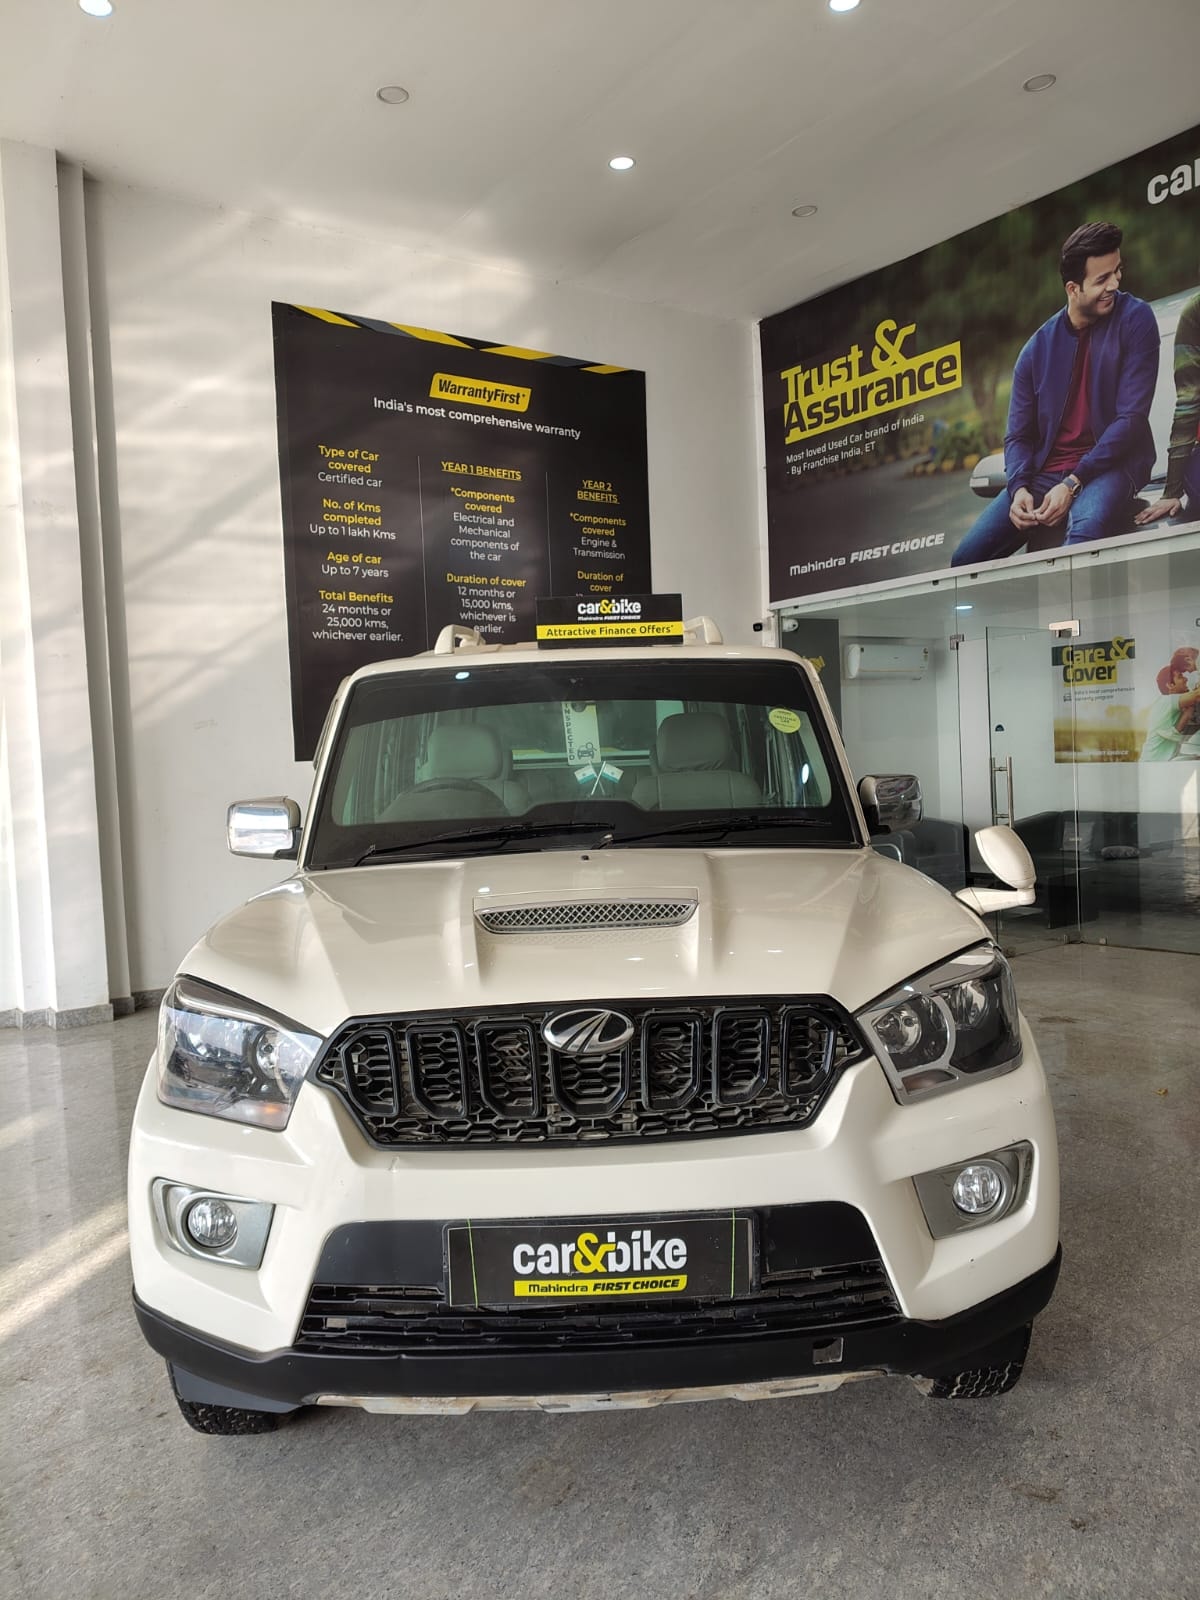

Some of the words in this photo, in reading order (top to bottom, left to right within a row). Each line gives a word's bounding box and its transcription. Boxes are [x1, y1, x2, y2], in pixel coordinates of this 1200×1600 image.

[780, 344, 864, 402] Trust
[871, 319, 917, 371] &
[785, 354, 958, 437] Assurance
[373, 397, 413, 413] India's
[415, 404, 446, 418] most
[448, 409, 533, 431] comprehensive
[534, 423, 581, 440] warranty
[786, 450, 805, 464] Most
[806, 442, 827, 458] loved
[828, 438, 848, 452] Used
[849, 433, 863, 444] Car
[864, 423, 889, 440] brand
[891, 419, 900, 431] of
[902, 413, 925, 427] India
[318, 444, 345, 458] Type
[347, 449, 359, 459] of
[361, 451, 380, 461] Car
[791, 464, 802, 475] By
[803, 452, 840, 471] Franchise
[840, 446, 864, 460] India,
[865, 441, 876, 453] ET
[328, 461, 372, 473] covered
[441, 461, 468, 474] YEAR
[469, 464, 474, 474] 1
[476, 465, 522, 481] BENEFITS
[317, 471, 364, 486] Certified
[366, 478, 383, 488] car
[582, 480, 605, 490] YEAR
[606, 482, 613, 491] 2
[577, 490, 618, 504] BENEFITS
[323, 499, 341, 509] No.
[343, 500, 355, 511] of
[357, 502, 381, 513] Kms
[465, 502, 502, 514] covered
[323, 513, 382, 526] completed
[453, 512, 495, 525] Electrical
[497, 517, 515, 527] and
[309, 524, 326, 536] Up
[328, 526, 339, 536] to
[341, 526, 346, 536] 1
[348, 527, 370, 538] lakh
[373, 529, 397, 540] Kms
[459, 525, 511, 538] Mechanical
[582, 526, 615, 536] covered
[450, 538, 509, 550] components
[510, 541, 520, 551] of
[581, 536, 610, 548] Engine
[611, 540, 617, 548] &
[327, 552, 349, 563] Age
[351, 553, 363, 563] of
[365, 555, 382, 564] car
[470, 551, 486, 561] the
[487, 552, 502, 562] car
[572, 547, 626, 560] Transmission
[789, 556, 846, 576] Mahindra
[850, 544, 891, 564] FIRST
[891, 532, 945, 555] CHOICE
[321, 564, 338, 576] Up
[340, 565, 351, 575] to
[352, 566, 360, 576] 7
[361, 568, 389, 578] years
[577, 570, 614, 581] Duration
[615, 573, 625, 582] of
[446, 573, 488, 585] Duration
[490, 575, 500, 586] of
[501, 578, 527, 587] cover
[458, 586, 467, 596] 12
[469, 587, 504, 598] months
[506, 589, 516, 599] or
[589, 584, 612, 592] cover
[319, 590, 346, 601] Total
[348, 591, 394, 603] Benefits
[322, 603, 335, 614] 24
[338, 604, 379, 616] months
[380, 607, 392, 616] or
[461, 598, 491, 609] 15,000
[492, 599, 514, 611] kms,
[459, 610, 507, 622] whichever
[508, 612, 517, 622] is
[326, 616, 362, 628] 25,000
[364, 618, 389, 630] kms,
[312, 630, 367, 641] whichever
[369, 631, 404, 642] earlier.
[546, 627, 597, 637] Attractive
[599, 626, 637, 636] Finance
[1062, 645, 1106, 665] Care
[1109, 636, 1136, 660] &
[1062, 664, 1116, 683] Cover
[528, 1283, 588, 1293] Mahindra
[592, 1281, 632, 1292] FIRST
[632, 1278, 680, 1290] CHOICE
